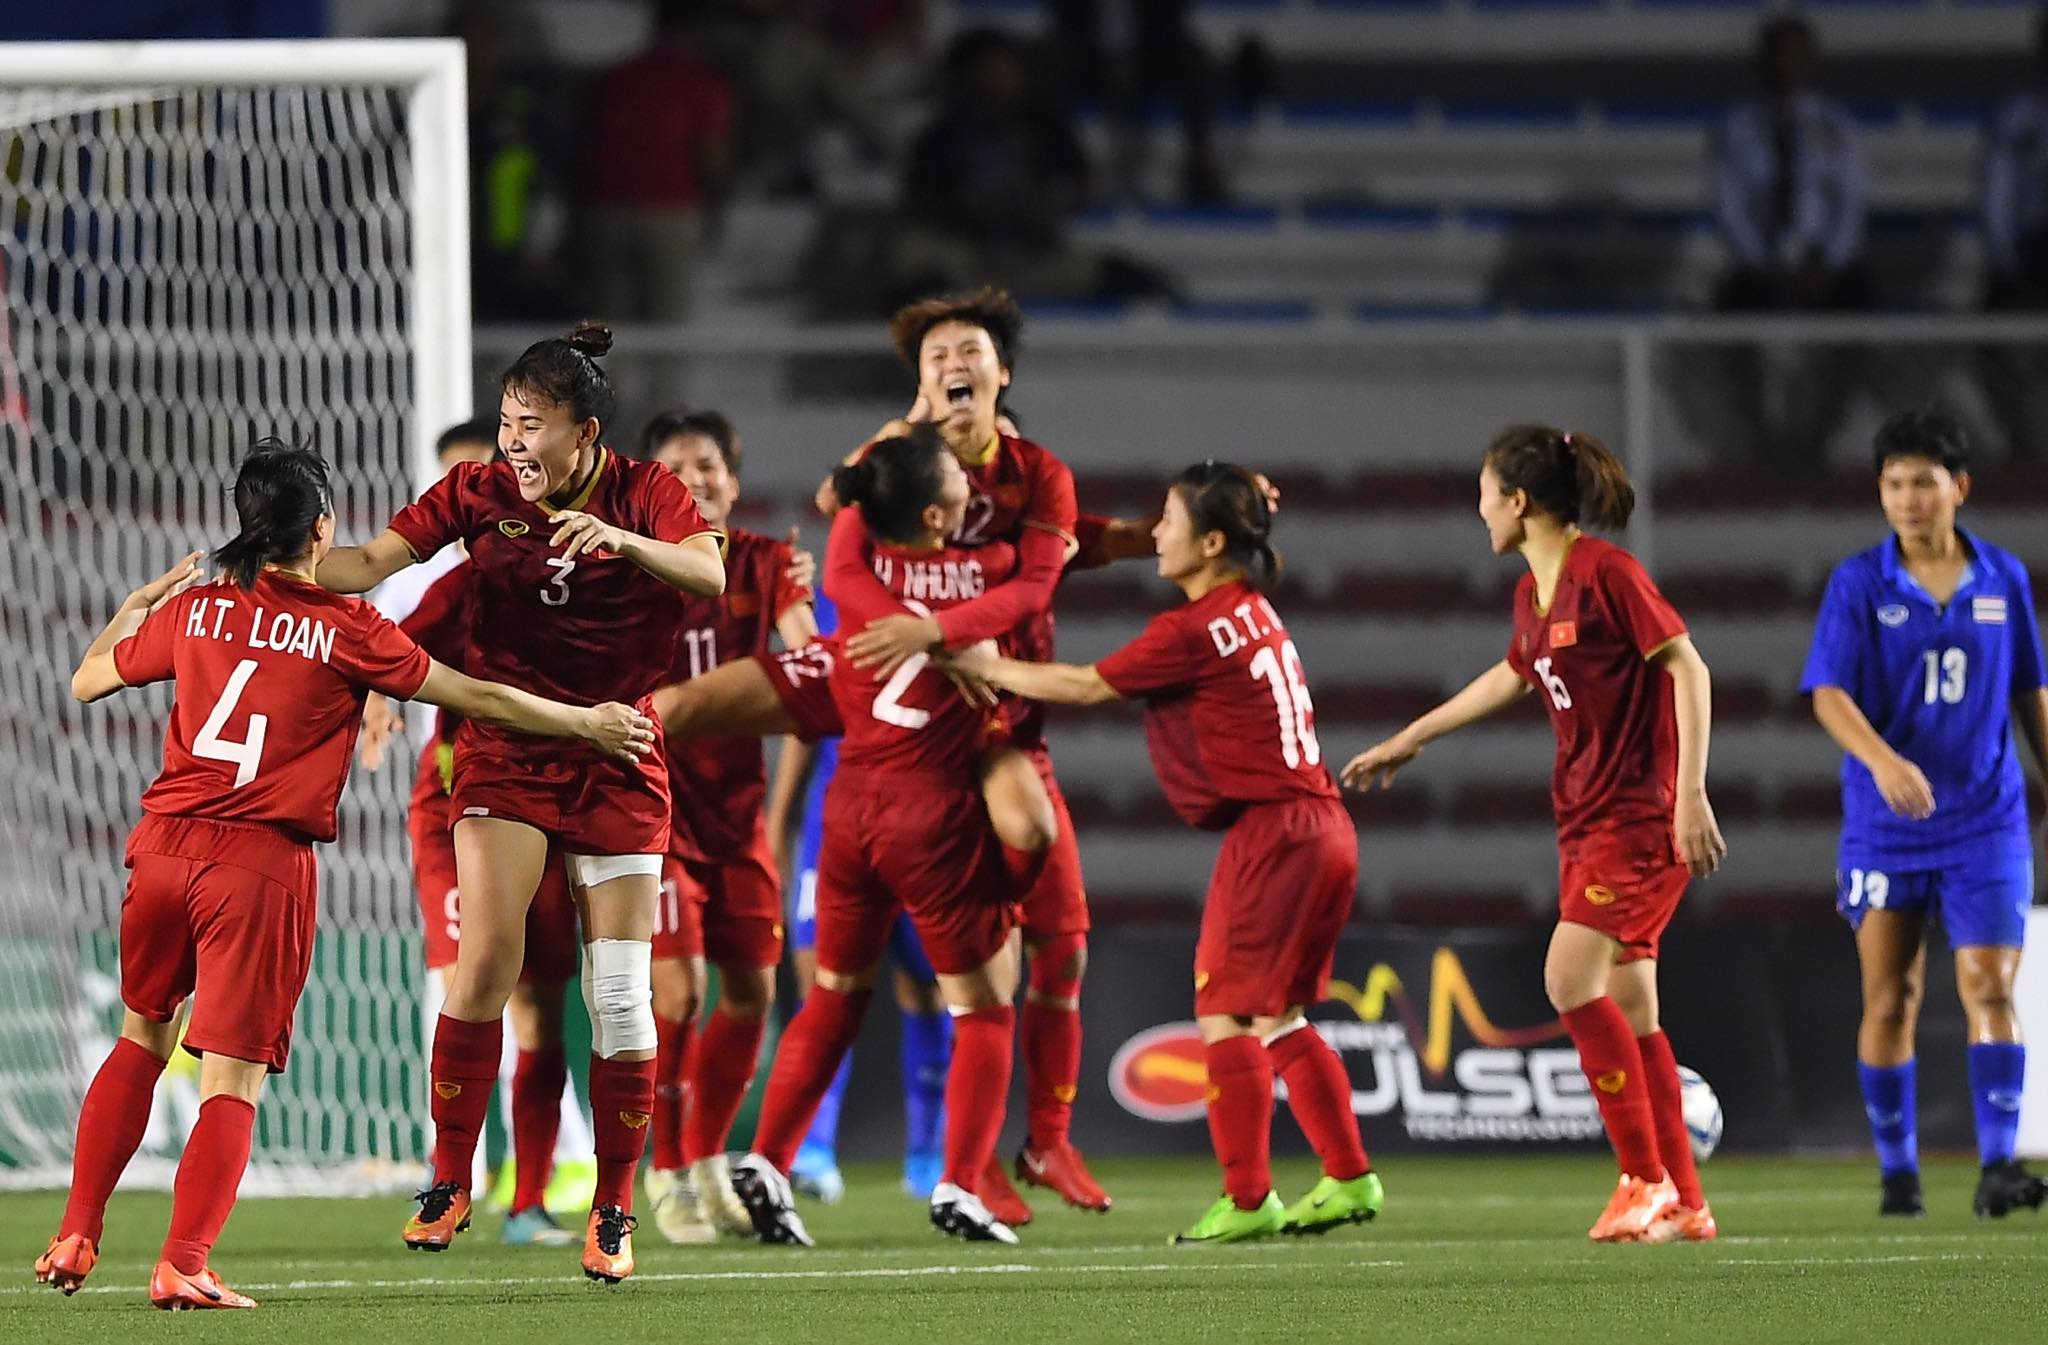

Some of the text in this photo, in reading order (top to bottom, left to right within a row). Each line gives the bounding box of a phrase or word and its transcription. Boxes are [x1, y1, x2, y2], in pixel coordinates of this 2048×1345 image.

[540, 557, 576, 606] 3
[903, 559, 986, 600] NHUNG
[185, 597, 337, 664] H.T. LOAN
[685, 627, 718, 681] 11
[872, 598, 932, 730] 2
[1923, 647, 1967, 705] 13
[192, 659, 268, 789] 4
